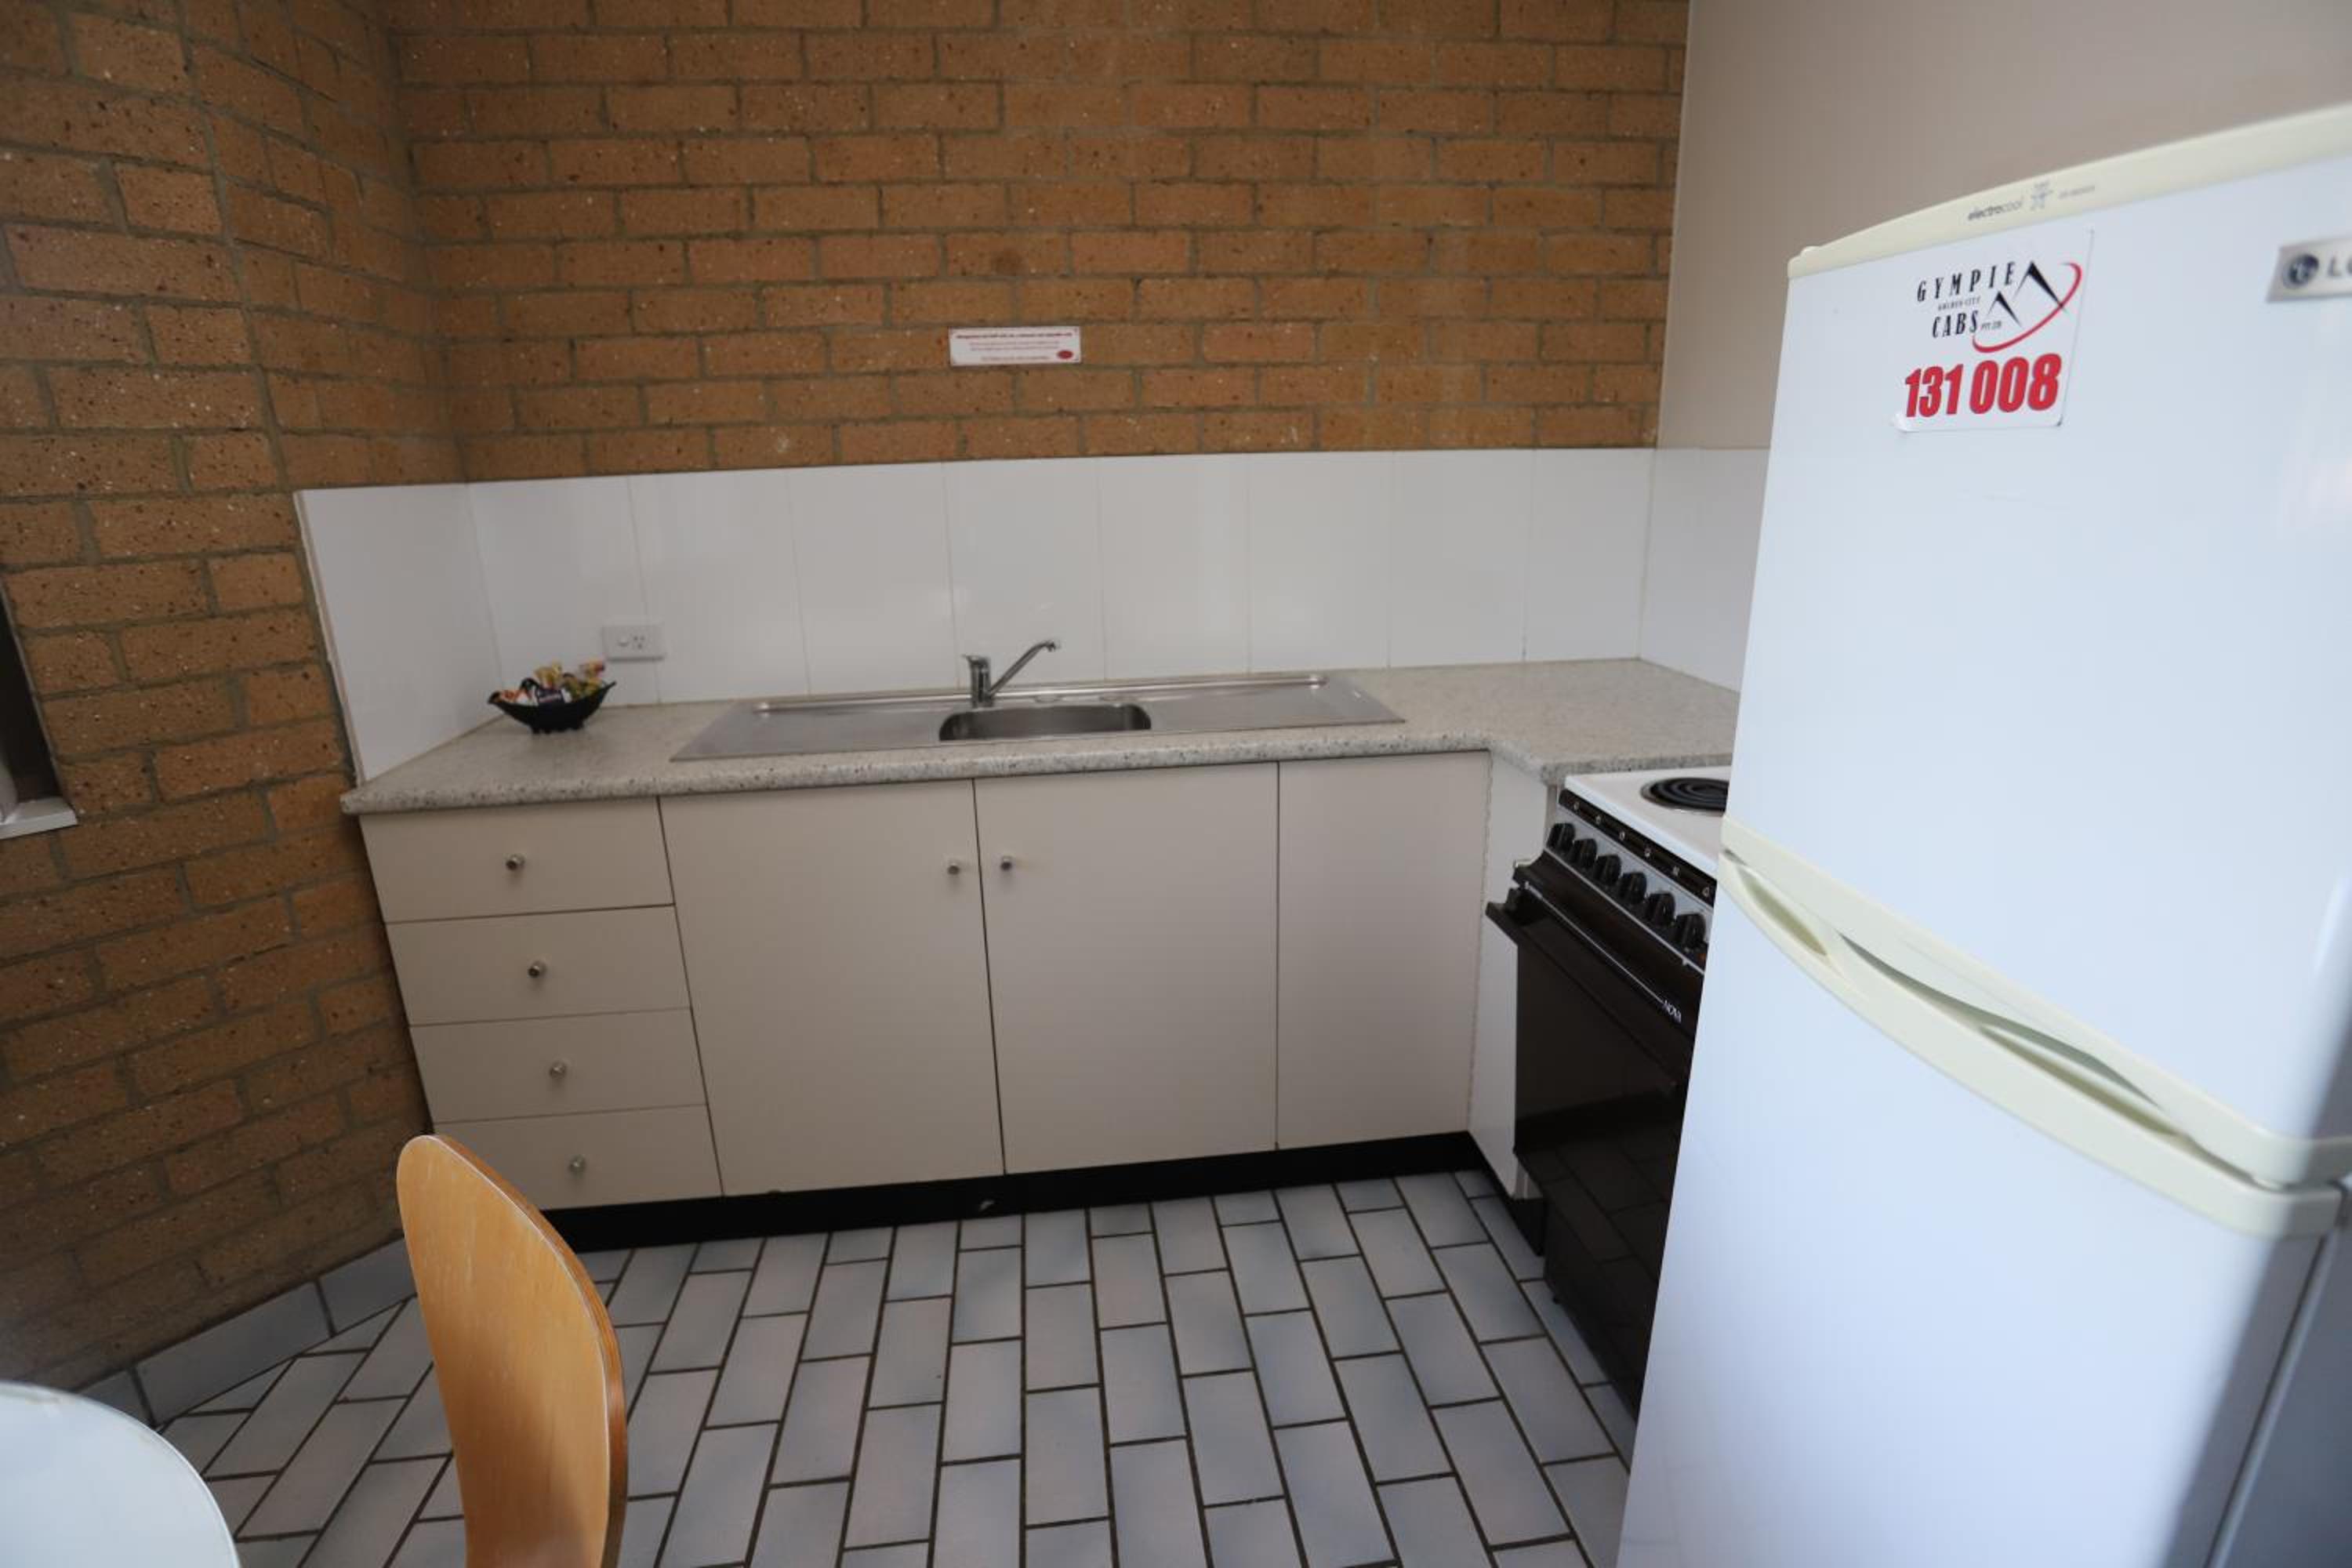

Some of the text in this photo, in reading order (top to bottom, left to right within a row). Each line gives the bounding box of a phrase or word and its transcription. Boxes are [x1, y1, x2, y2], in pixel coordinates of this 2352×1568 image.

[1917, 261, 2016, 302] GYMPIE
[1933, 310, 1978, 339] CABS
[1905, 353, 2062, 417] 131 008
